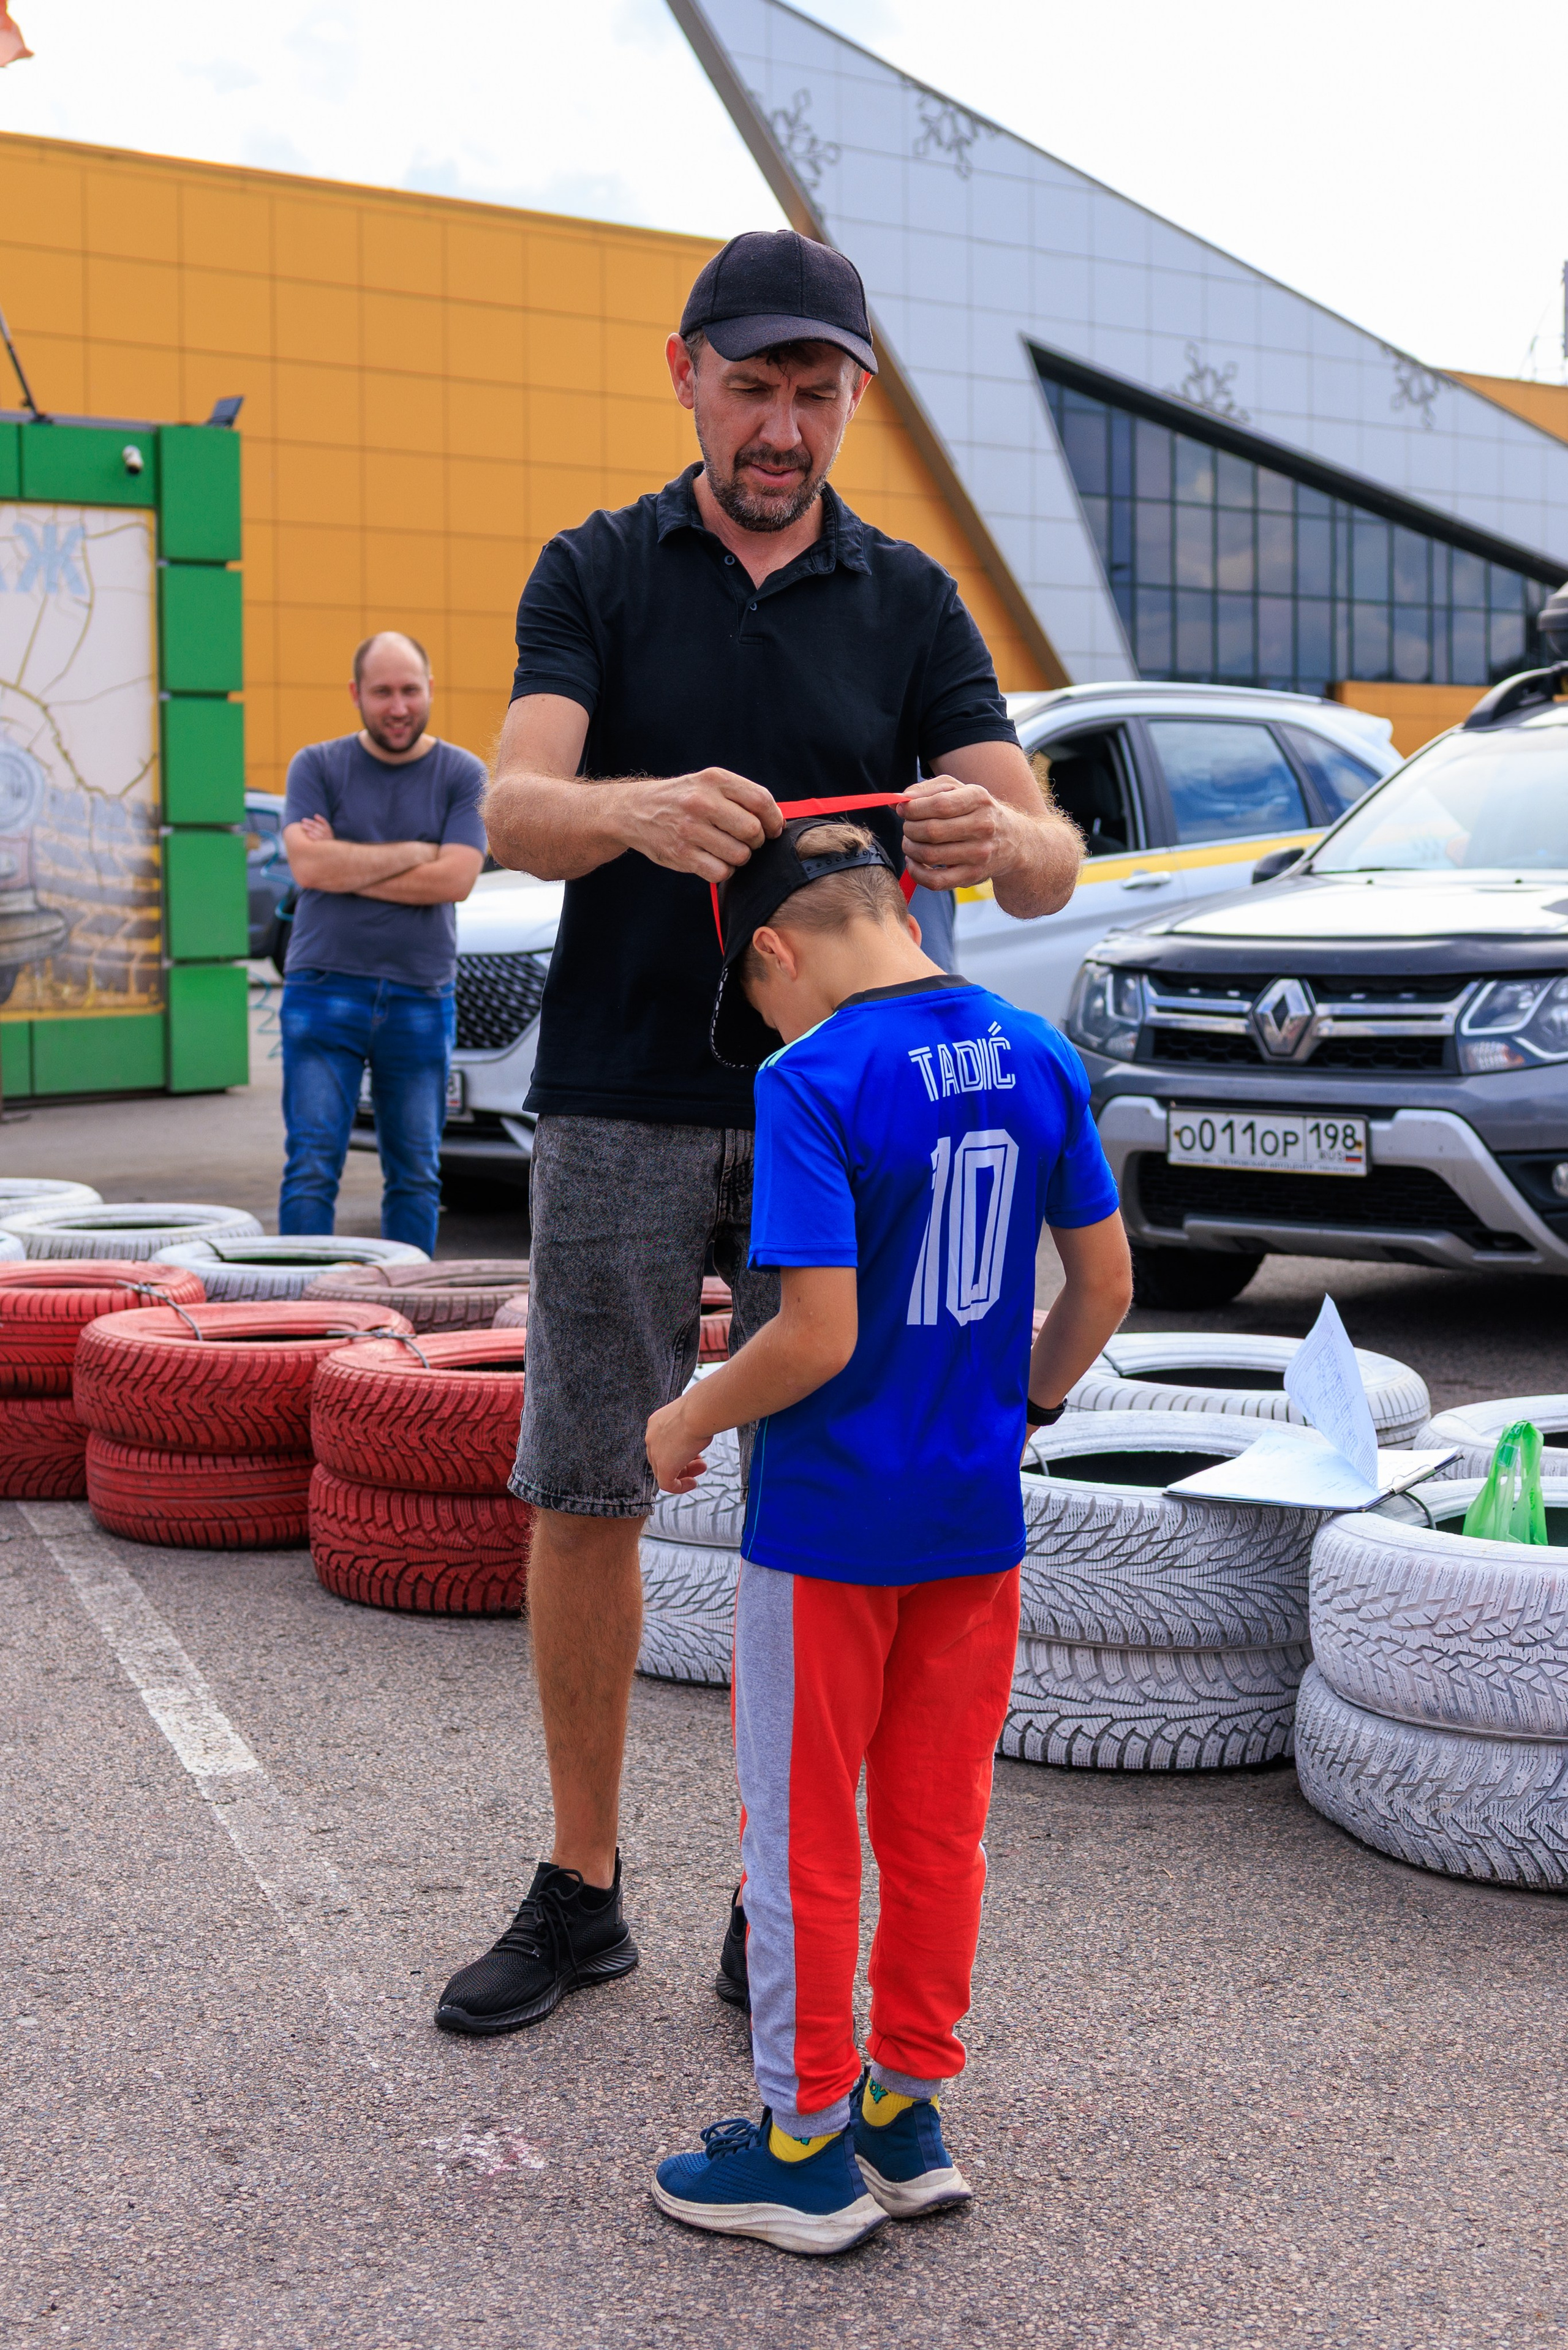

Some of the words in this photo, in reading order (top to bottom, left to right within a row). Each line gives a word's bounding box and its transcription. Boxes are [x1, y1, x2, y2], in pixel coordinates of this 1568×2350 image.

[908, 1021, 1016, 1102] TADIĆ
[1309, 1122, 1357, 1150] 198
[1319, 1149, 1345, 1161] RUS
[907, 1129, 1019, 1327] 10
